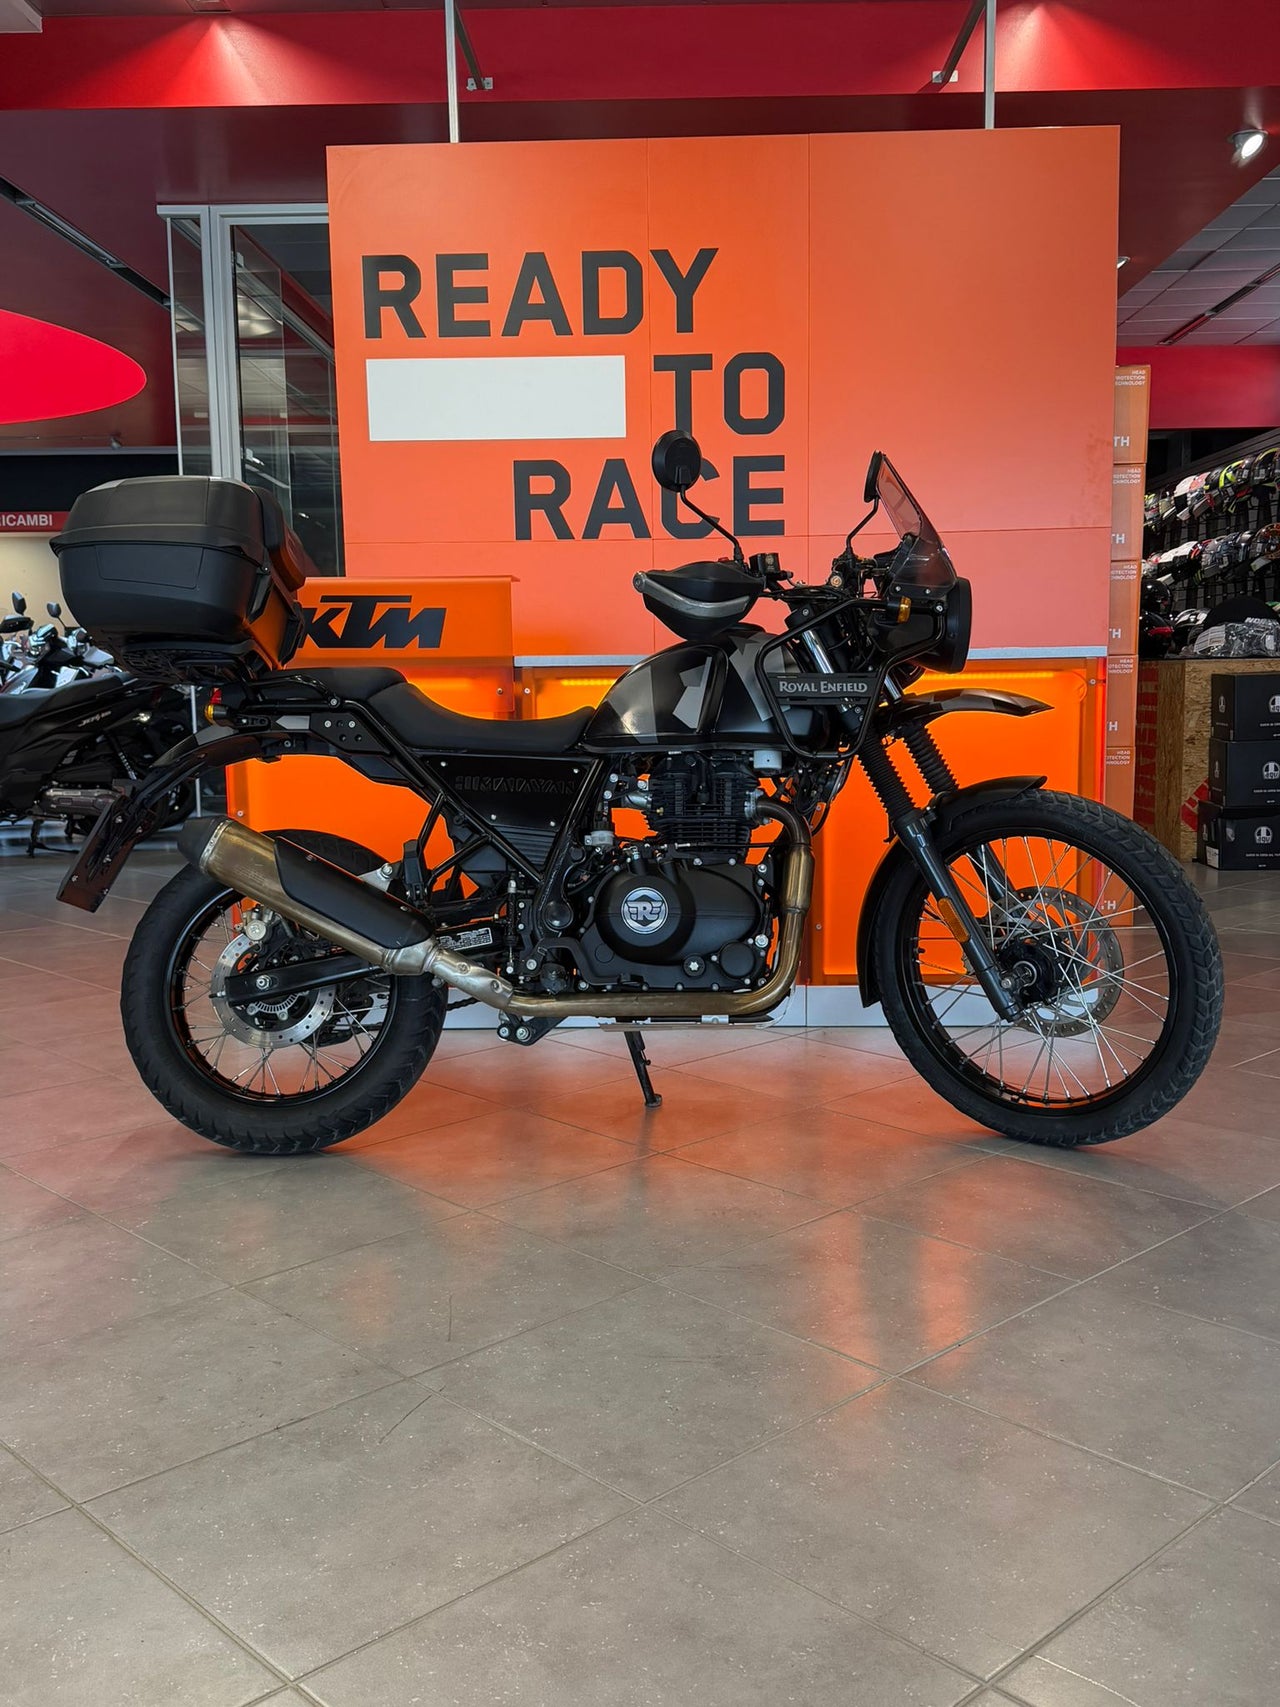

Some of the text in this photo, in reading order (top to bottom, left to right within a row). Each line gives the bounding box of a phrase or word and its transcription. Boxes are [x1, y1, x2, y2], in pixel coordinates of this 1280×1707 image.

[361, 247, 719, 339] READY
[653, 351, 785, 435] TO
[0, 514, 53, 526] ICAMBI
[513, 455, 785, 540] RACE
[298, 595, 447, 648] KTM
[779, 681, 868, 693] ROYAL ENFIELD
